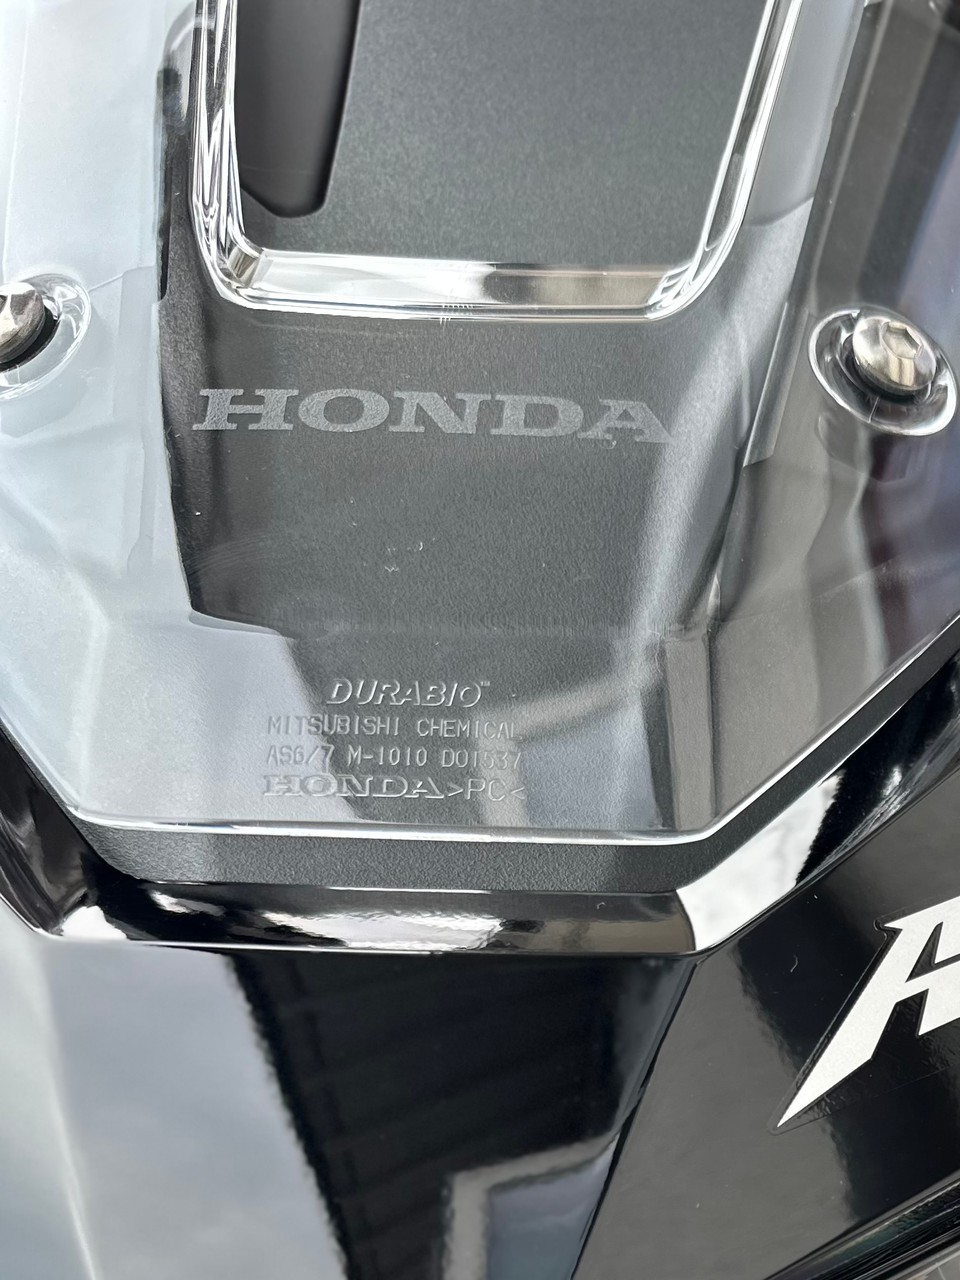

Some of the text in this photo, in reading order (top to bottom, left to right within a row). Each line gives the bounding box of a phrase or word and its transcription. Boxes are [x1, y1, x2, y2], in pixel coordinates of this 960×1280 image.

[192, 387, 674, 444] HONDA
[267, 713, 522, 741] MITSUBISHI CHEMICAL
[265, 743, 334, 768] AS6/7
[346, 743, 428, 767] M-1010
[263, 773, 445, 799] HONDA
